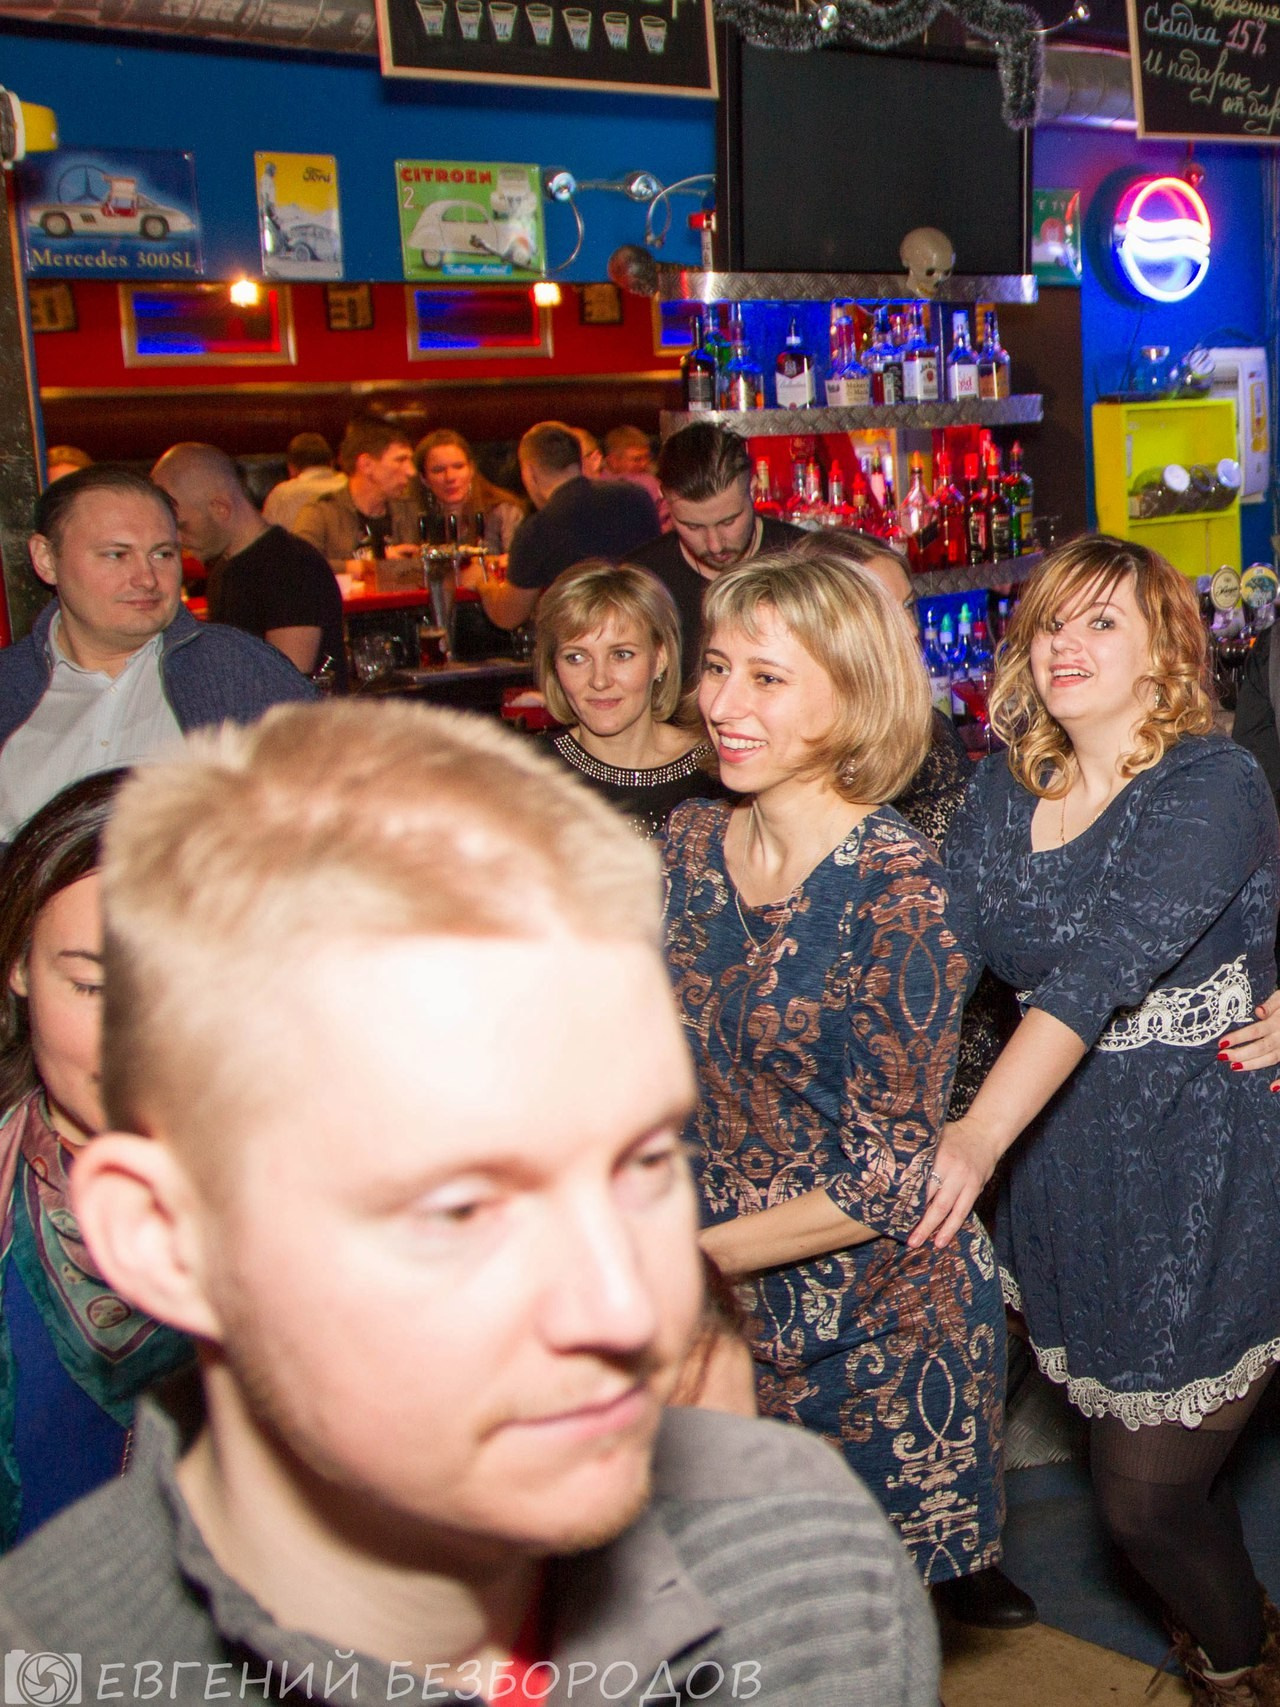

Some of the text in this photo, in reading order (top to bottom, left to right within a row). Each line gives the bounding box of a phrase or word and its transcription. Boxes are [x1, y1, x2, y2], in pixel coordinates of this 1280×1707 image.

[1144, 3, 1267, 54] Скидка 15%
[1166, 48, 1252, 104] подарок
[1222, 95, 1246, 115] от
[32, 249, 195, 269] Mercedes 300SL
